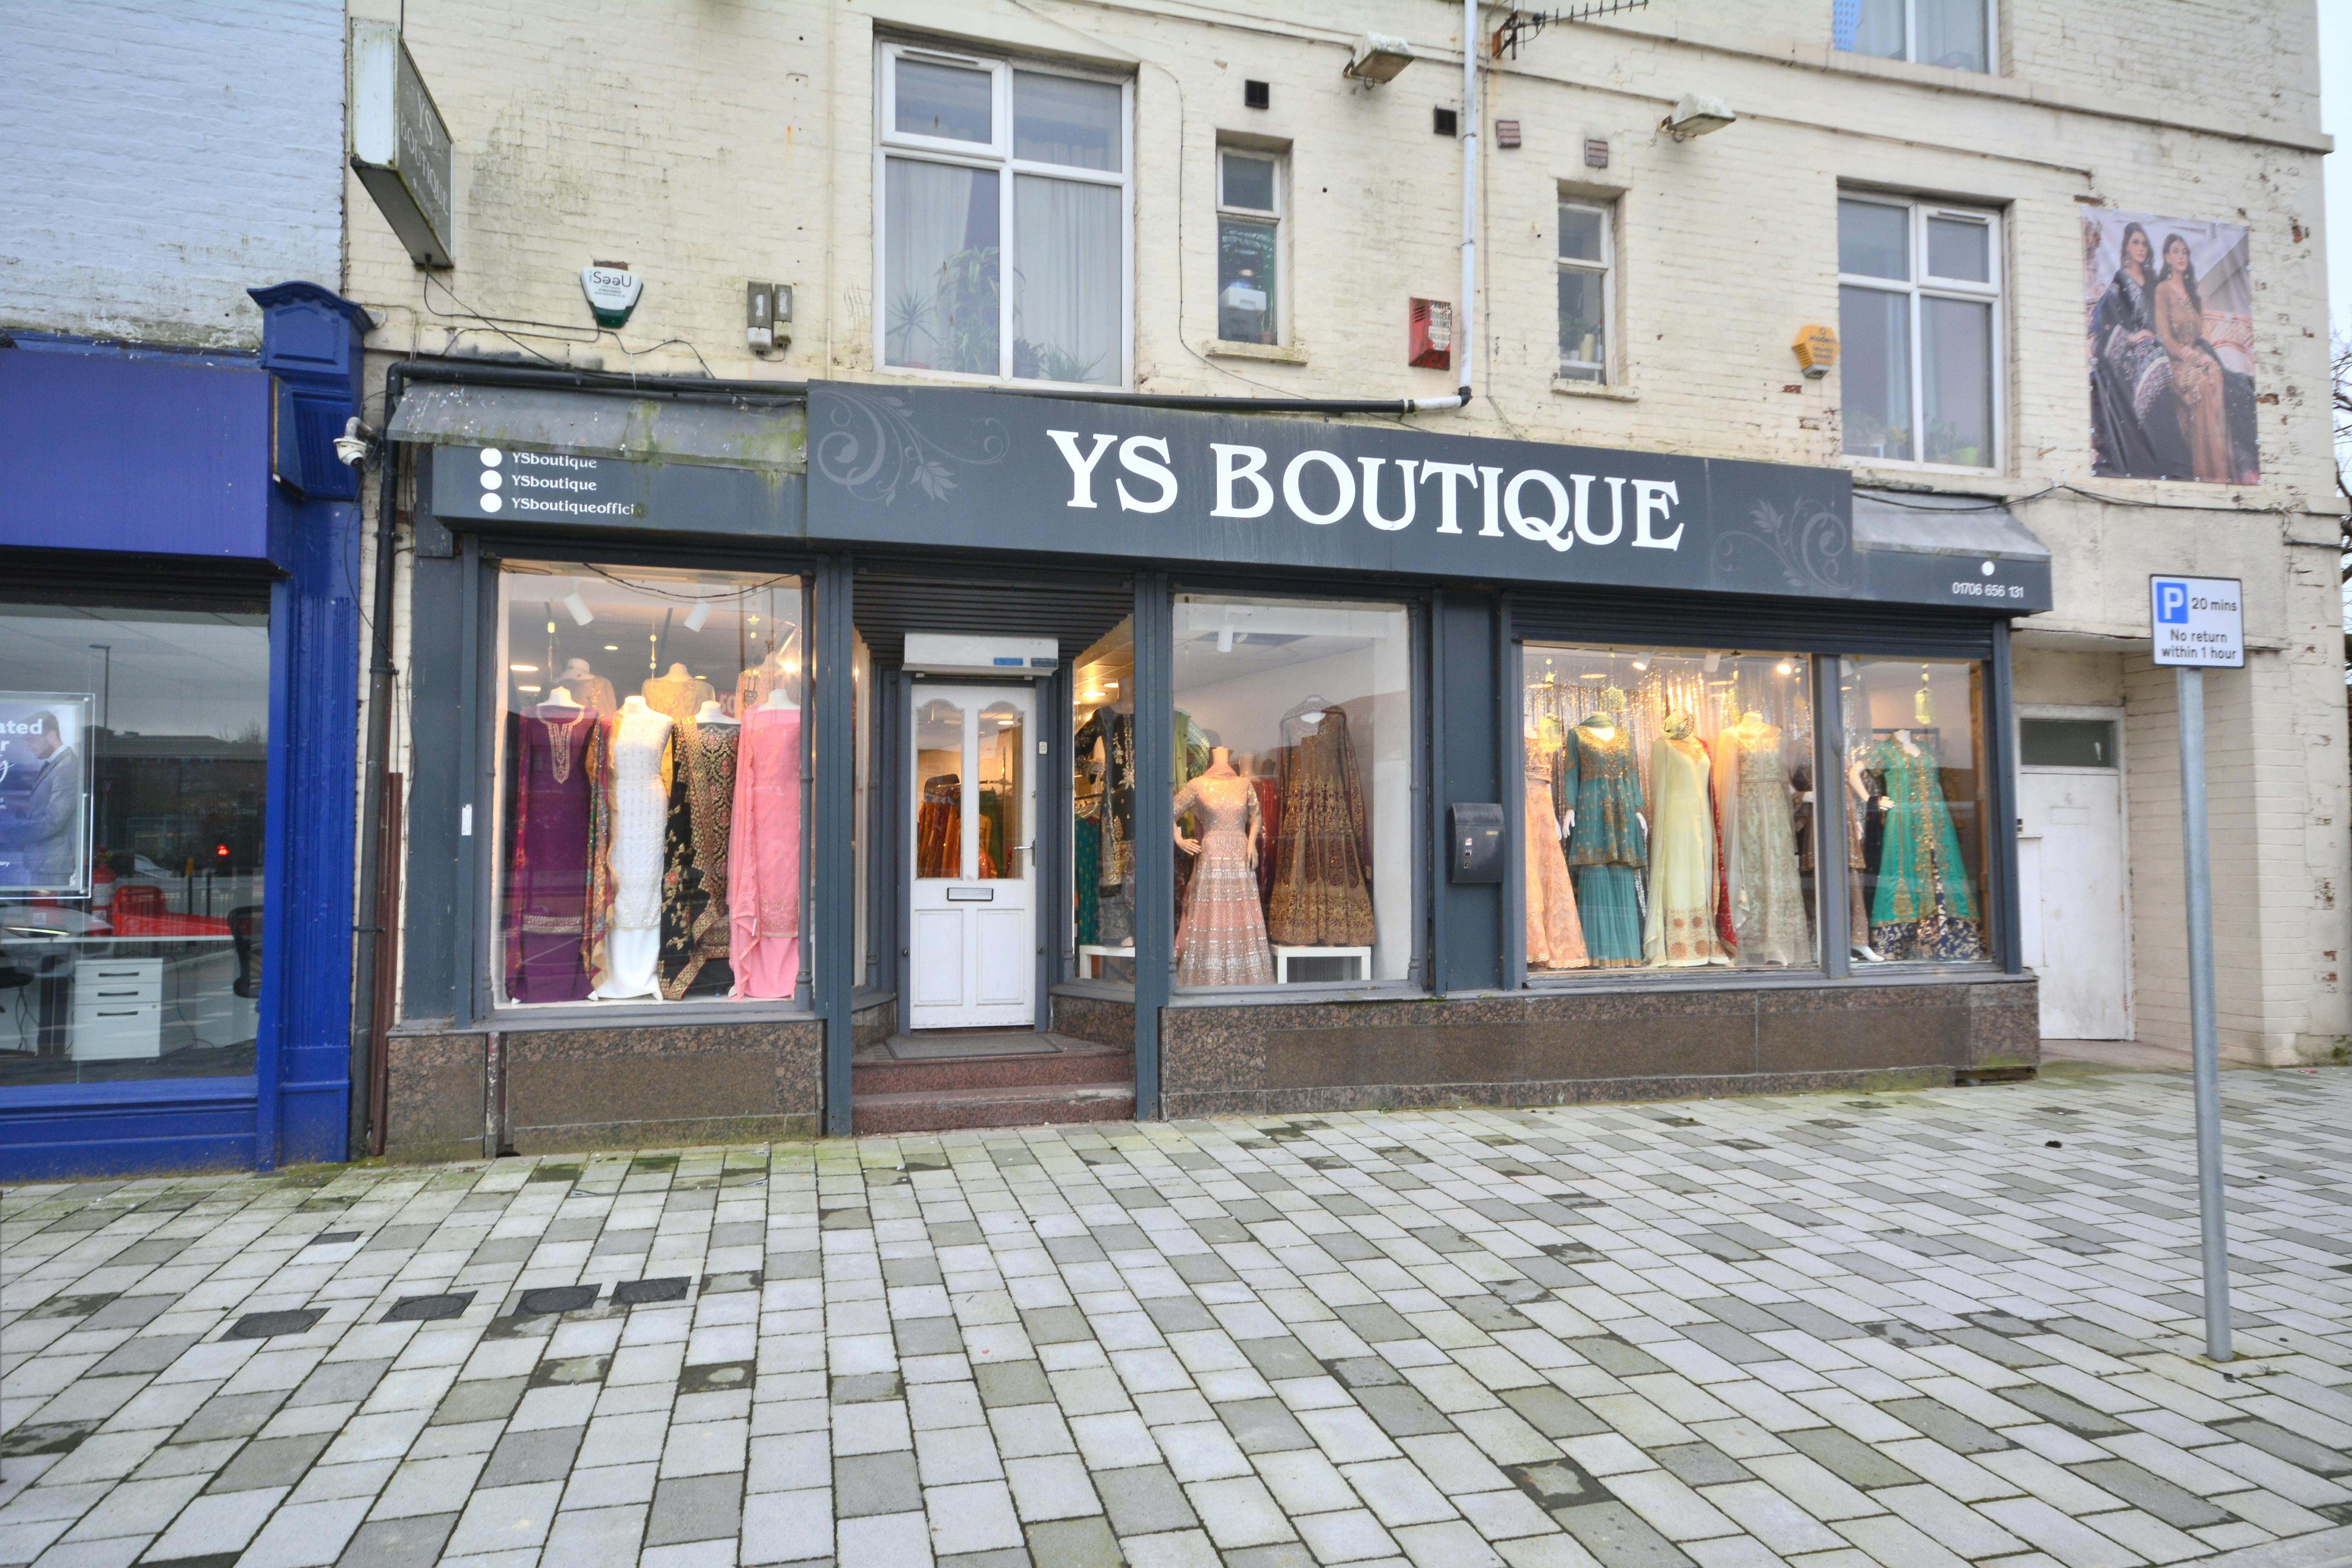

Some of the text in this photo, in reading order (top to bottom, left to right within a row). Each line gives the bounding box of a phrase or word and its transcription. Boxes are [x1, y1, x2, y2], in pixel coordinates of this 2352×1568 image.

[417, 90, 433, 146] YS
[401, 112, 448, 216] BOUTIQUE
[512, 452, 597, 469] YSboutique
[511, 474, 597, 492] YSboutique
[1046, 430, 1685, 552] YS BOUTIQUE
[1952, 582, 2024, 598] 01706 656 131
[2164, 587, 2184, 619] P
[2191, 597, 2237, 611] 20 mins
[2170, 629, 2227, 642] No return
[2161, 645, 2236, 659] within 1 hour
